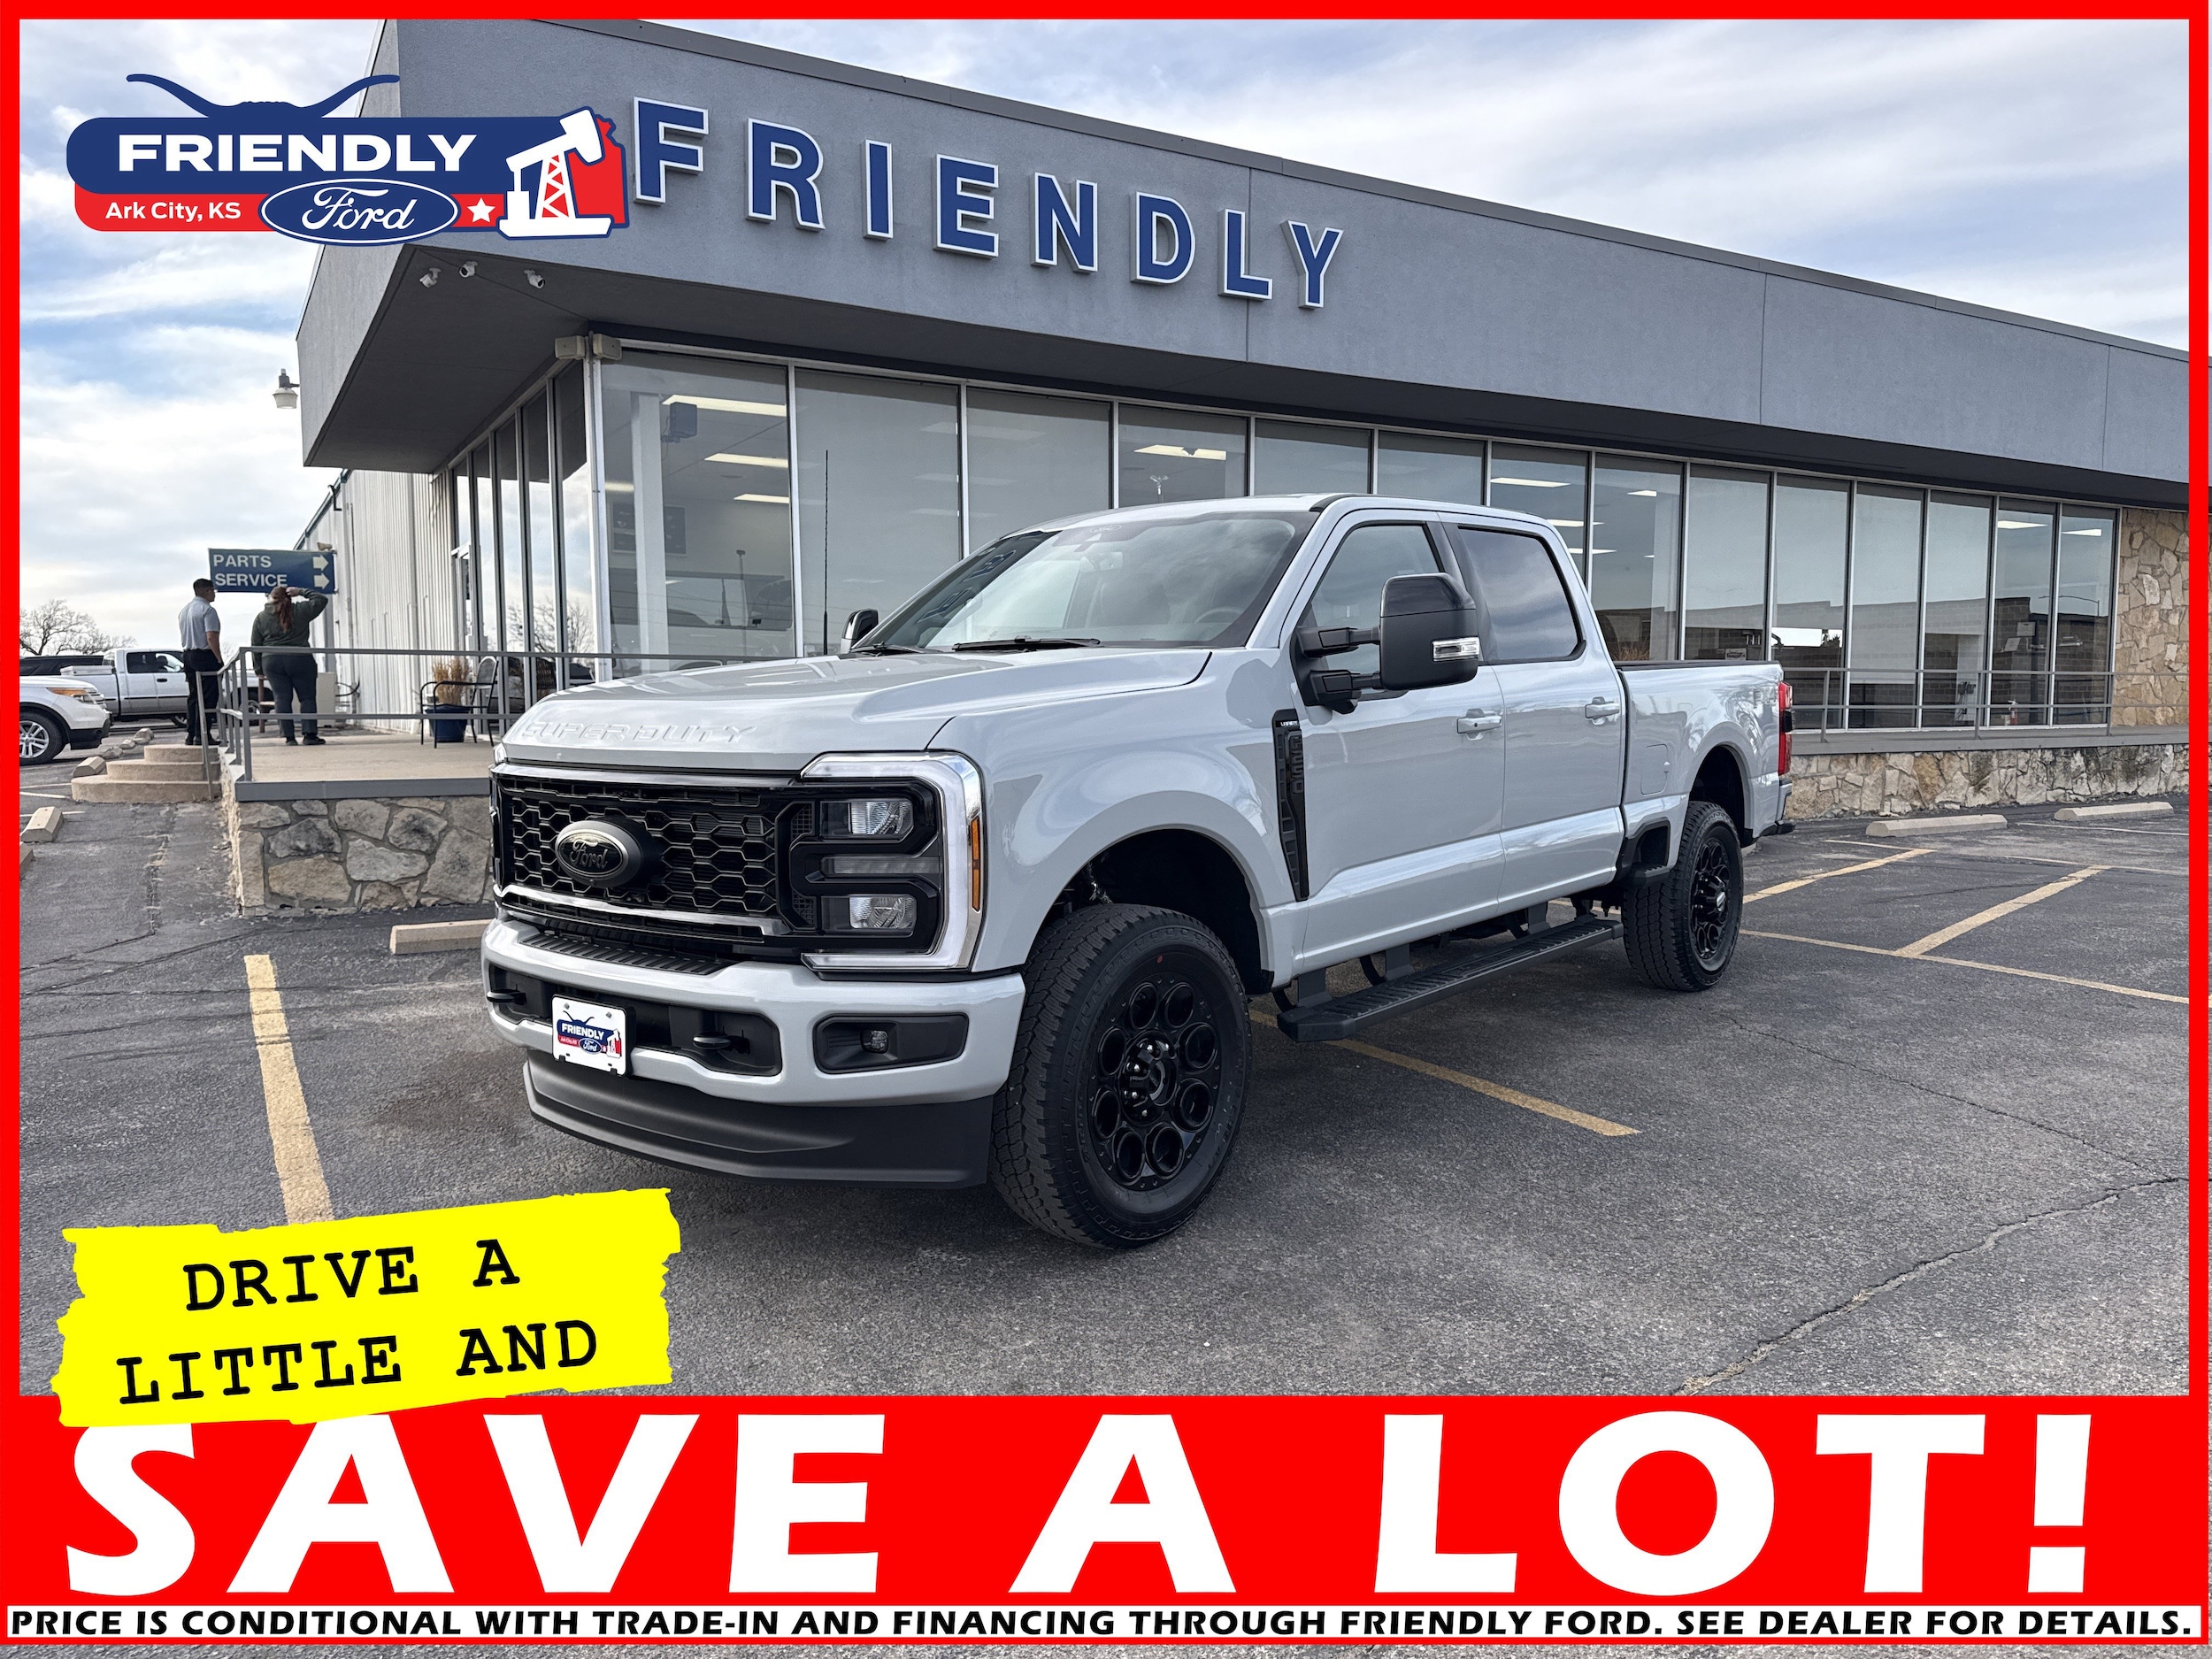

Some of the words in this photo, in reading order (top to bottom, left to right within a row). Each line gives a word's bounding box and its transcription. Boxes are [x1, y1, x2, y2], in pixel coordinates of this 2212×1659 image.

[633, 96, 1344, 310] FRIENDLY
[213, 554, 272, 568] PARTS
[215, 572, 288, 588] SERVICE
[521, 721, 630, 741] SUPER
[632, 724, 757, 743] DUTY
[569, 839, 609, 870] Ford
[561, 1023, 605, 1041] FRIENDLY
[582, 1040, 598, 1052] Ford
